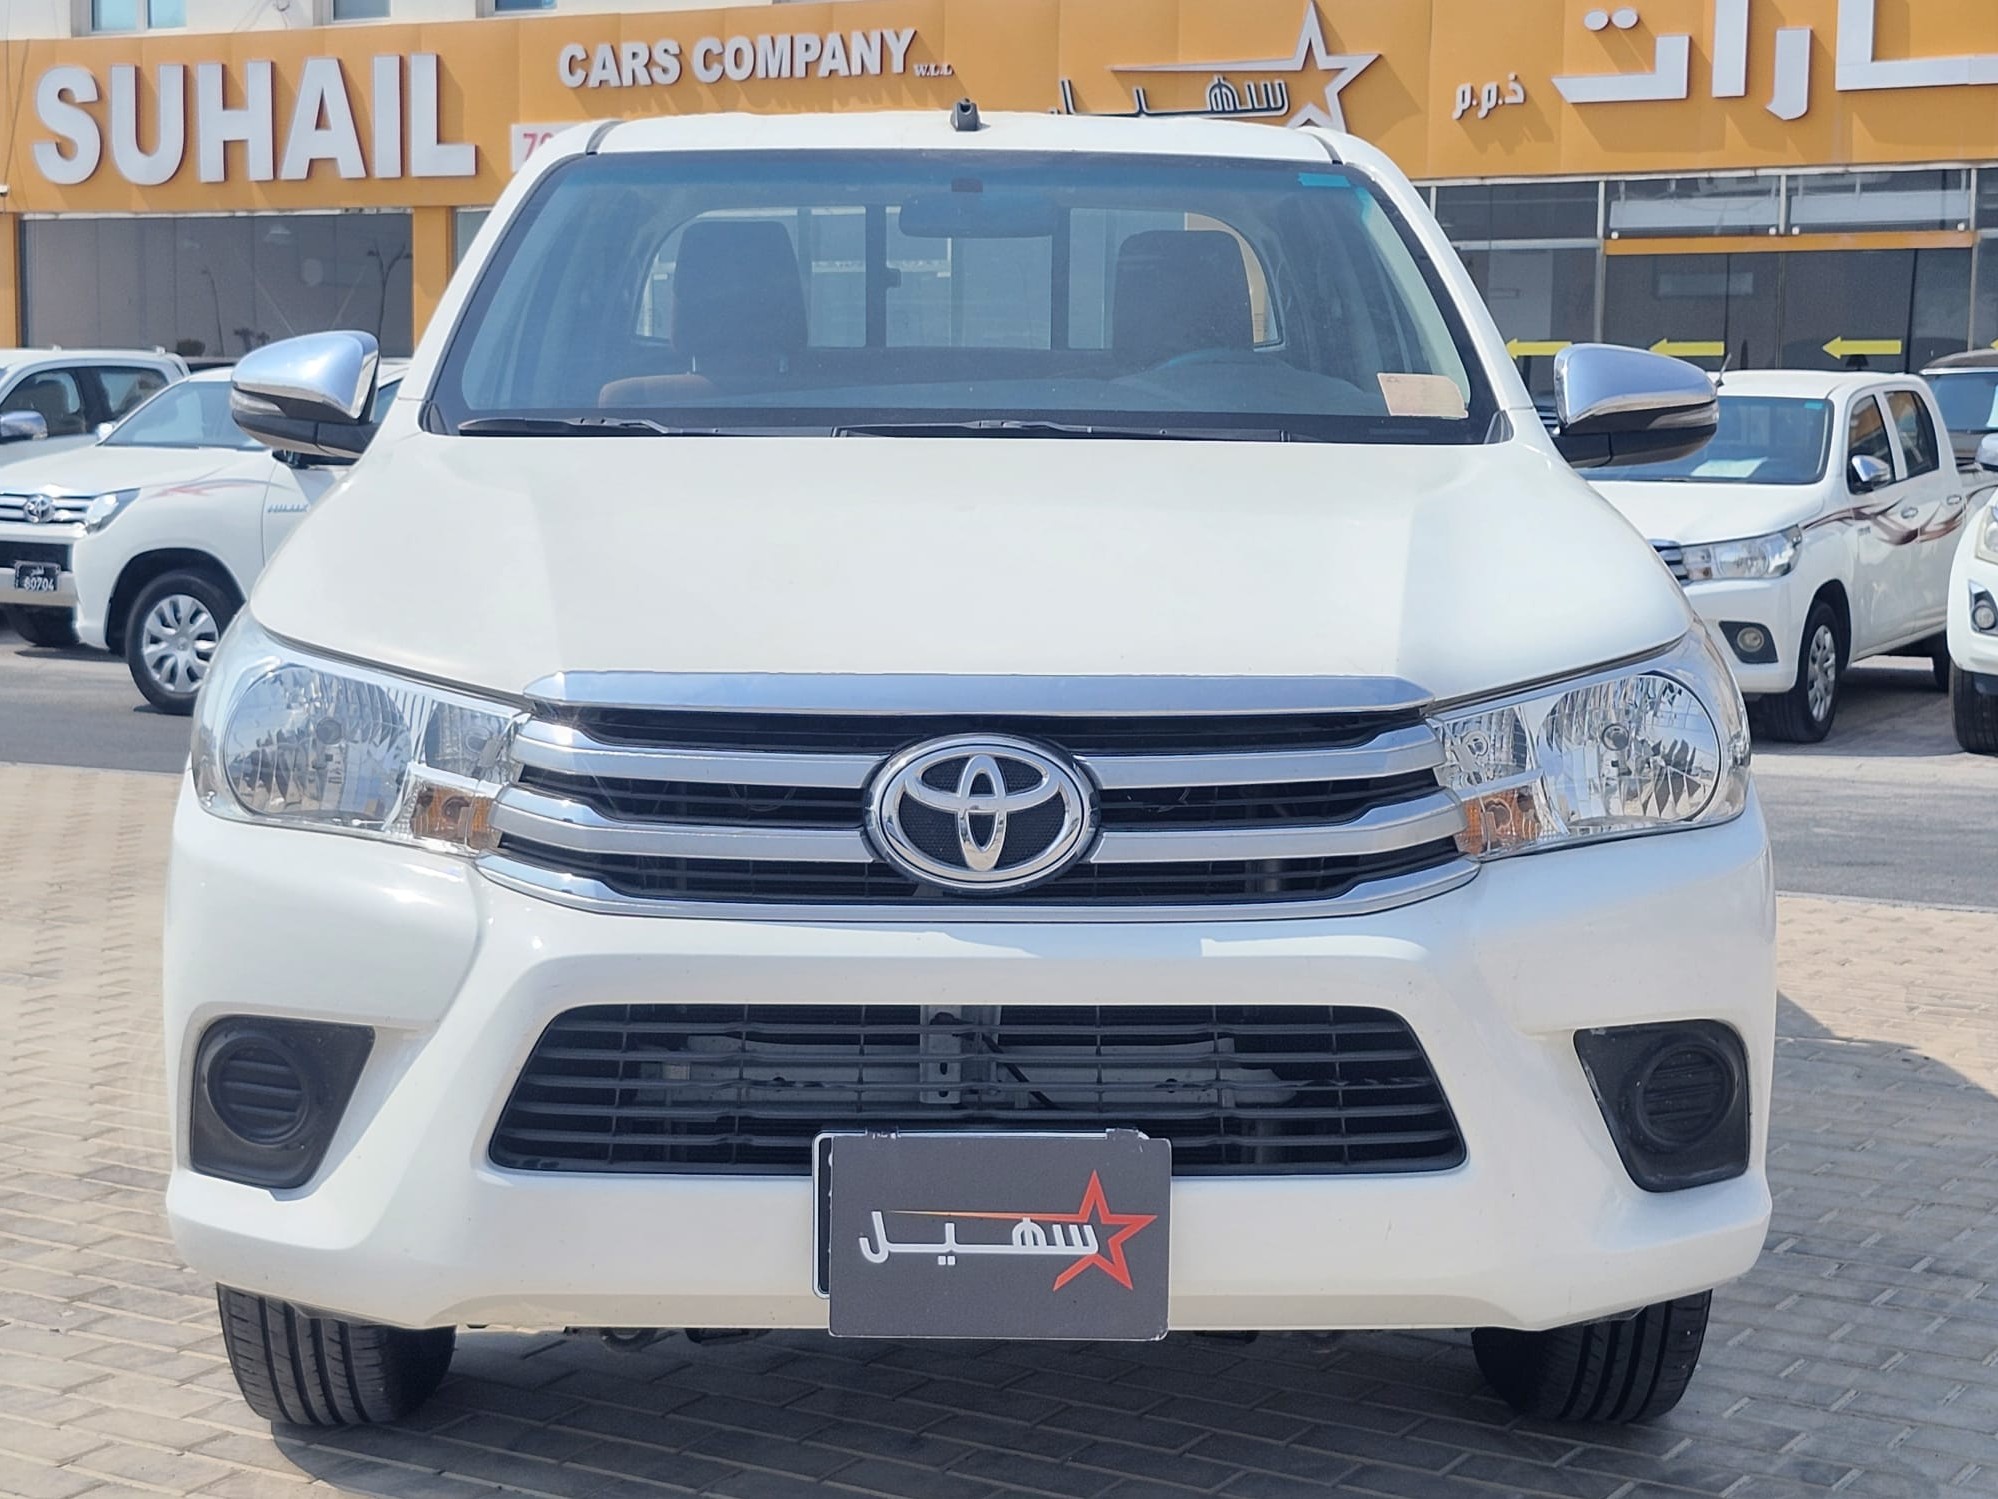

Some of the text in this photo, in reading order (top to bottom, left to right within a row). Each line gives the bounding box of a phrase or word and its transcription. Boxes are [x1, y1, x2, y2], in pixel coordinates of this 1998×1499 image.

[558, 39, 682, 88] CARS
[693, 28, 917, 84] COMPANY
[32, 53, 477, 186] SUHAIL
[858, 1210, 1099, 1265] سهيل
